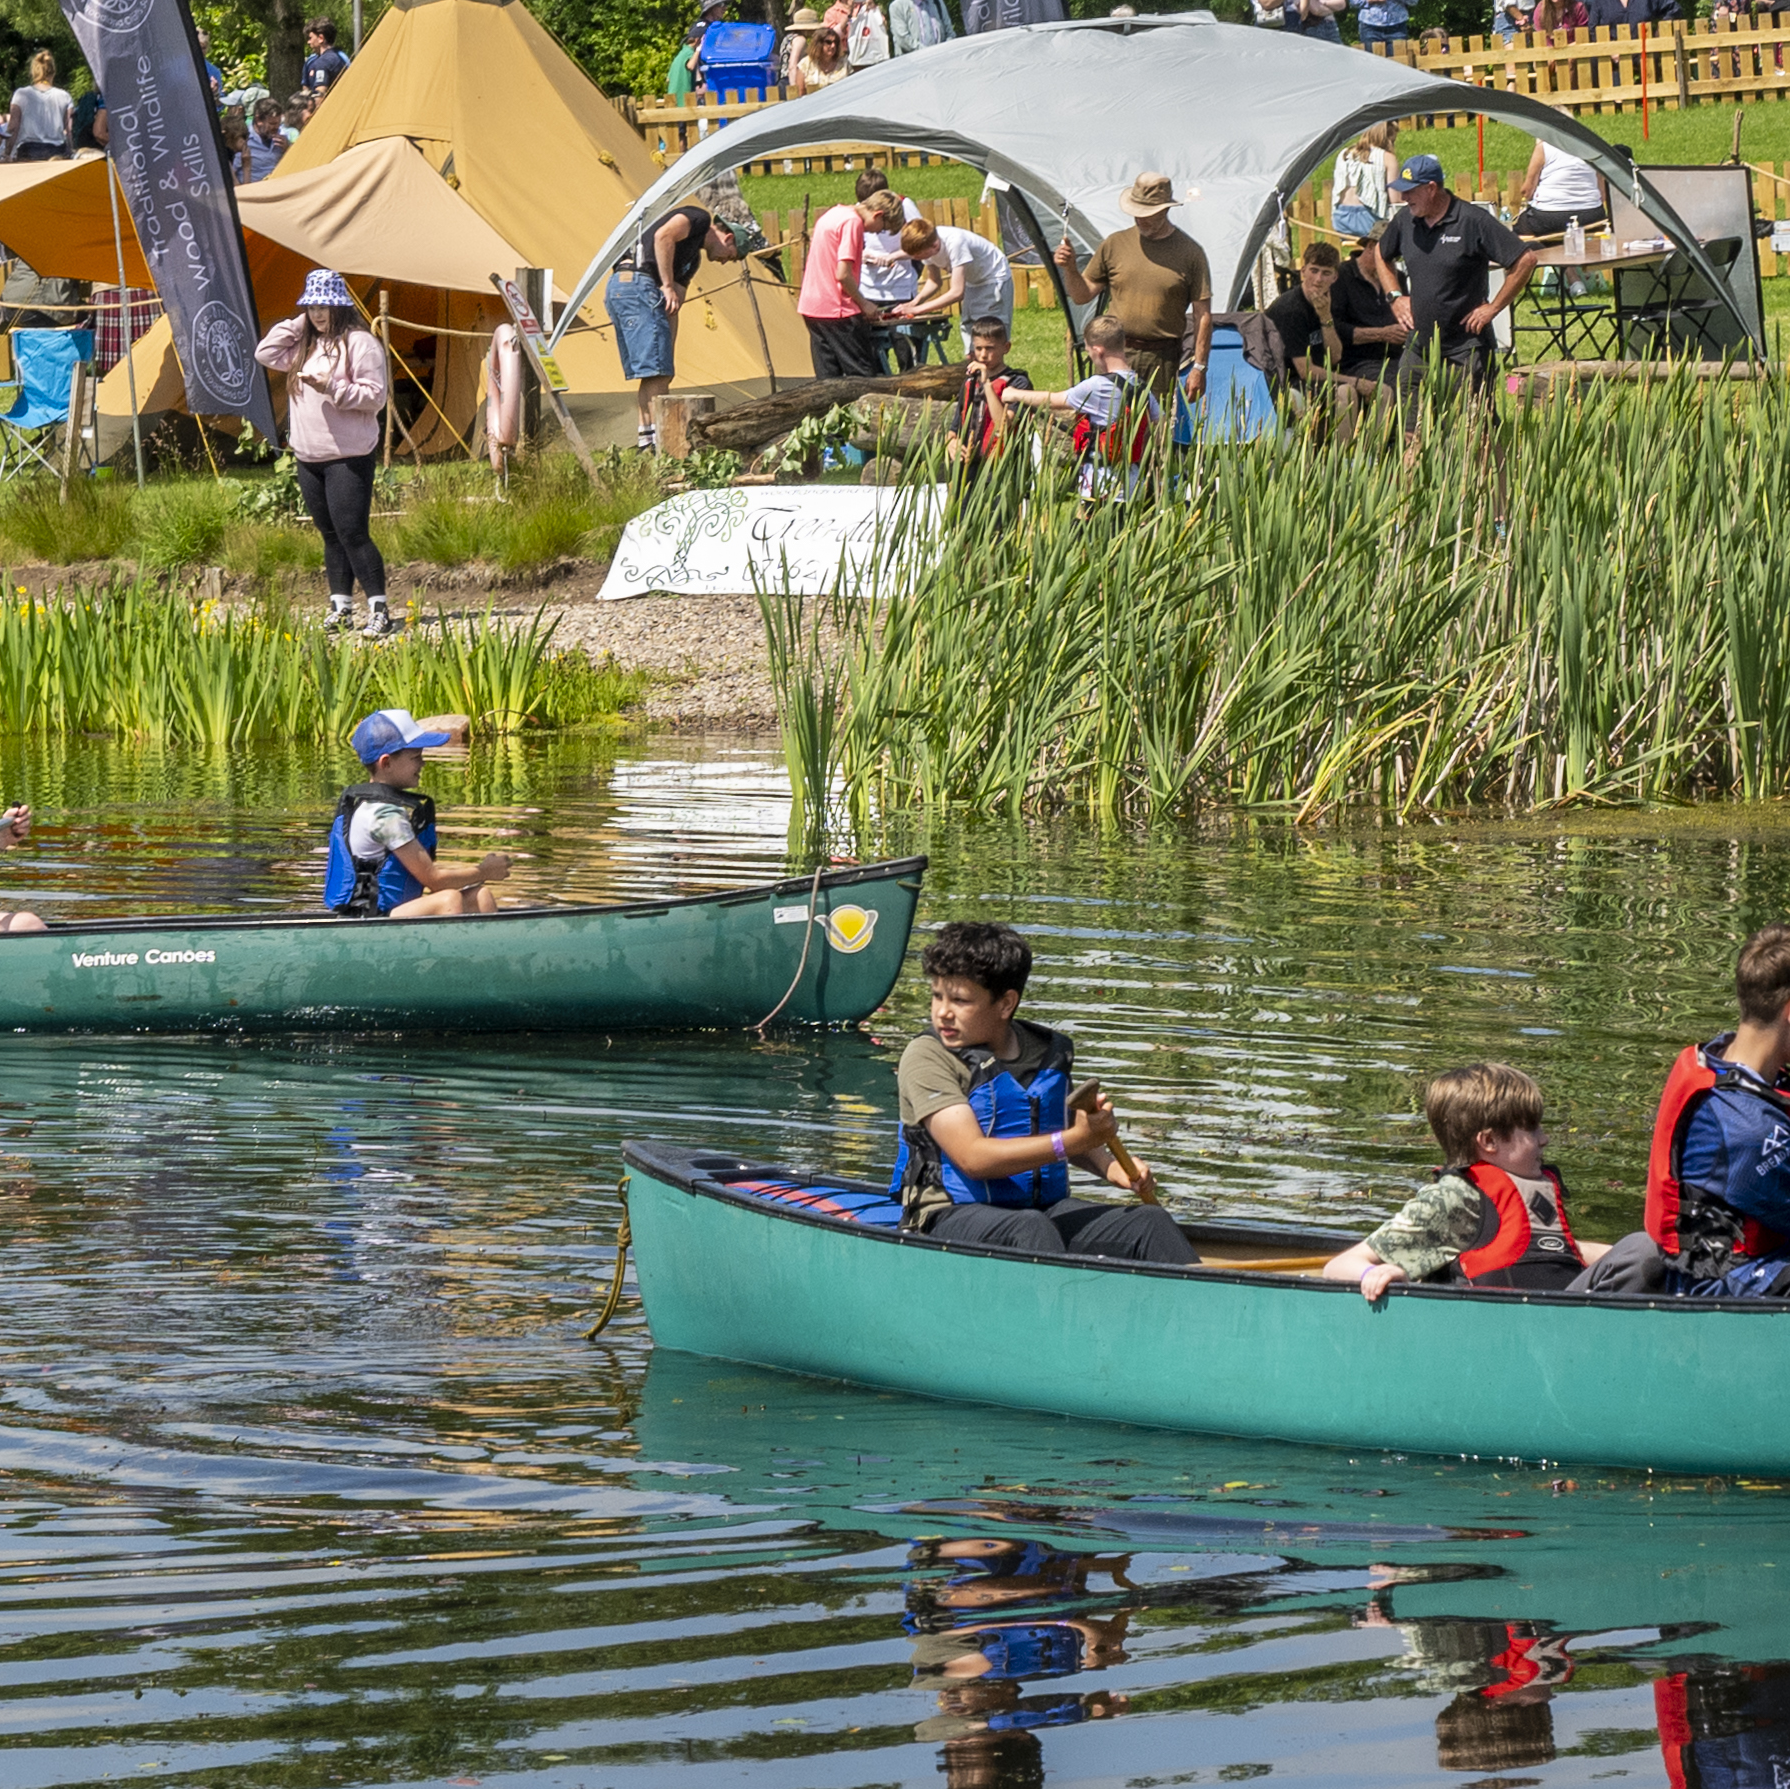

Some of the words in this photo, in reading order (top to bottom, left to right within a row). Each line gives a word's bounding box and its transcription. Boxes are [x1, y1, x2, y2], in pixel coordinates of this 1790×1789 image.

[137, 55, 169, 163] Wildlife
[111, 104, 169, 260] Traditional
[159, 168, 179, 191] &
[181, 133, 211, 198] Skills
[165, 201, 211, 292] Wood
[72, 951, 139, 968] Venture
[144, 949, 216, 964] Canoes
